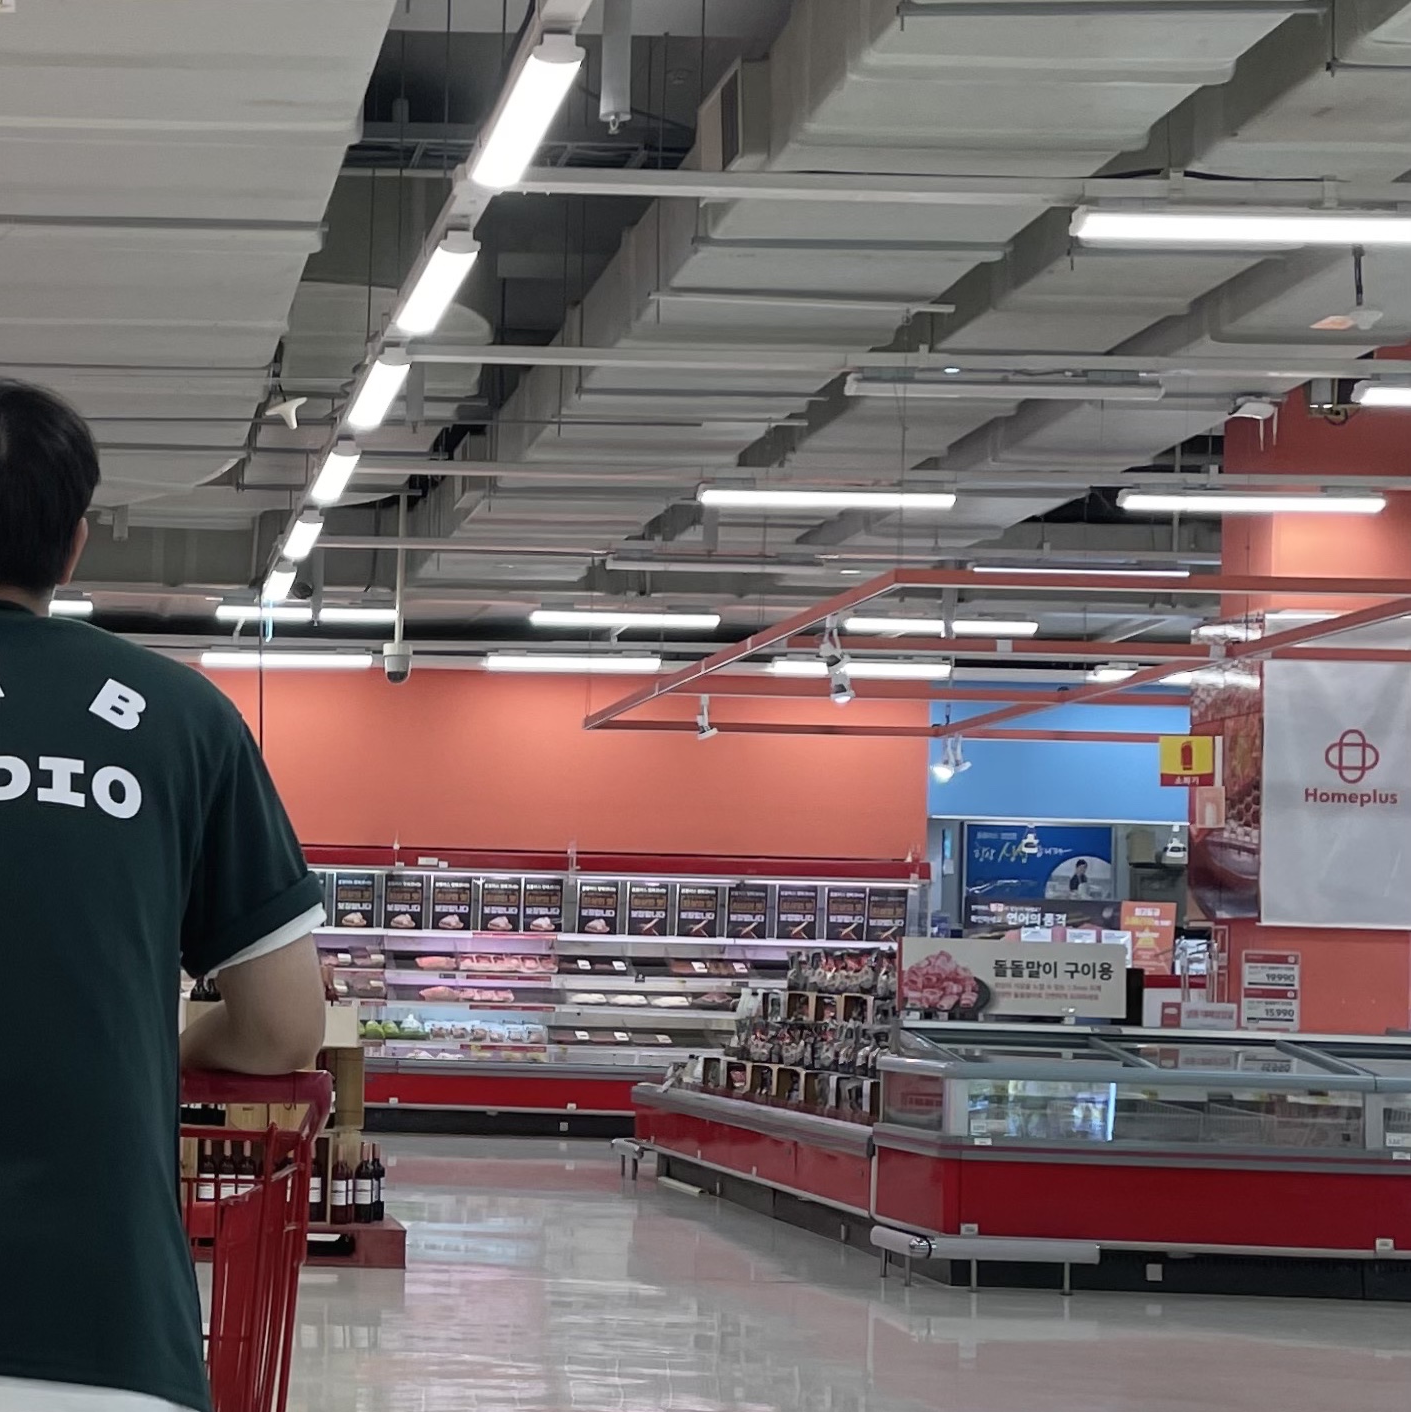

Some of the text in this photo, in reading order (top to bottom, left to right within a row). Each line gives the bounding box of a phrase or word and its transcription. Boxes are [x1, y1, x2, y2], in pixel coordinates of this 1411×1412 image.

[89, 678, 147, 730] B
[1174, 776, 1200, 786] 소화기
[1304, 788, 1398, 808] Homeplus
[993, 959, 1114, 981] 돌돌말이 구이용
